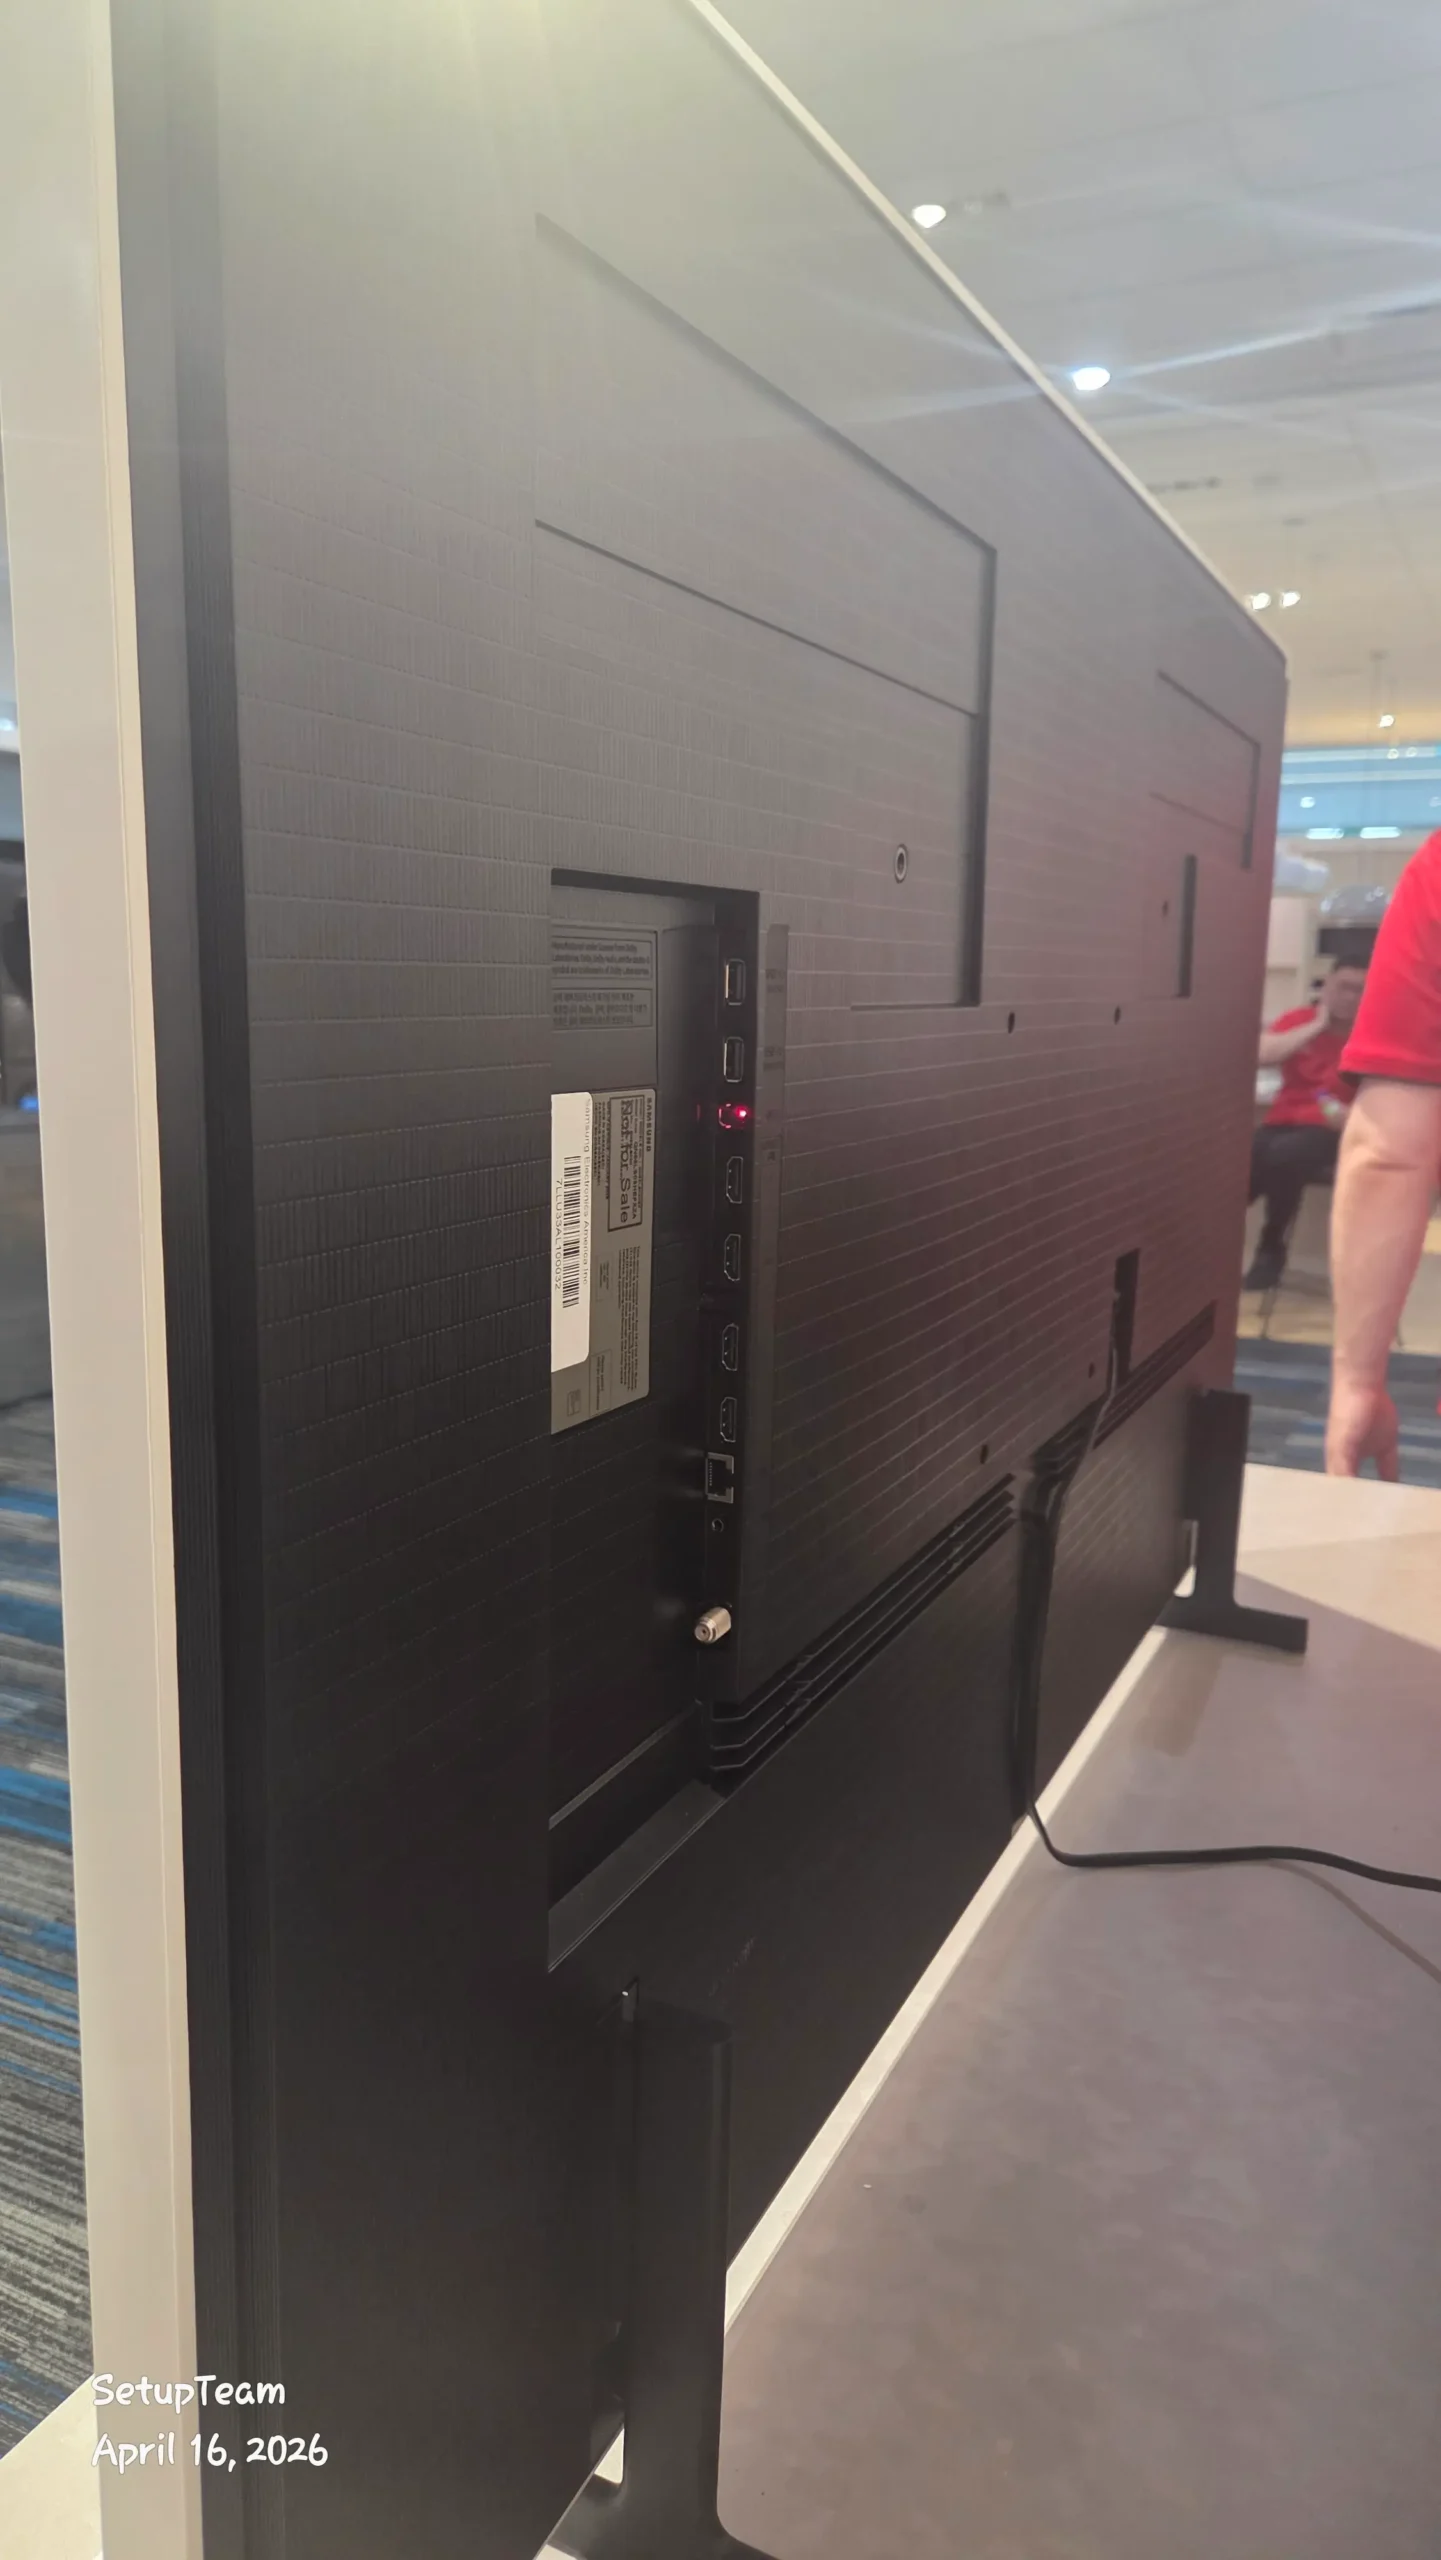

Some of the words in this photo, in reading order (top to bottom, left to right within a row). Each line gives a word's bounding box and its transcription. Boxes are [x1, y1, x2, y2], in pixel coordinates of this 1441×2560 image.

[620, 1099, 633, 1141] Not
[645, 1097, 653, 1153] SAMSUNG
[620, 1144, 632, 1171] for
[620, 1177, 631, 1223] Sale
